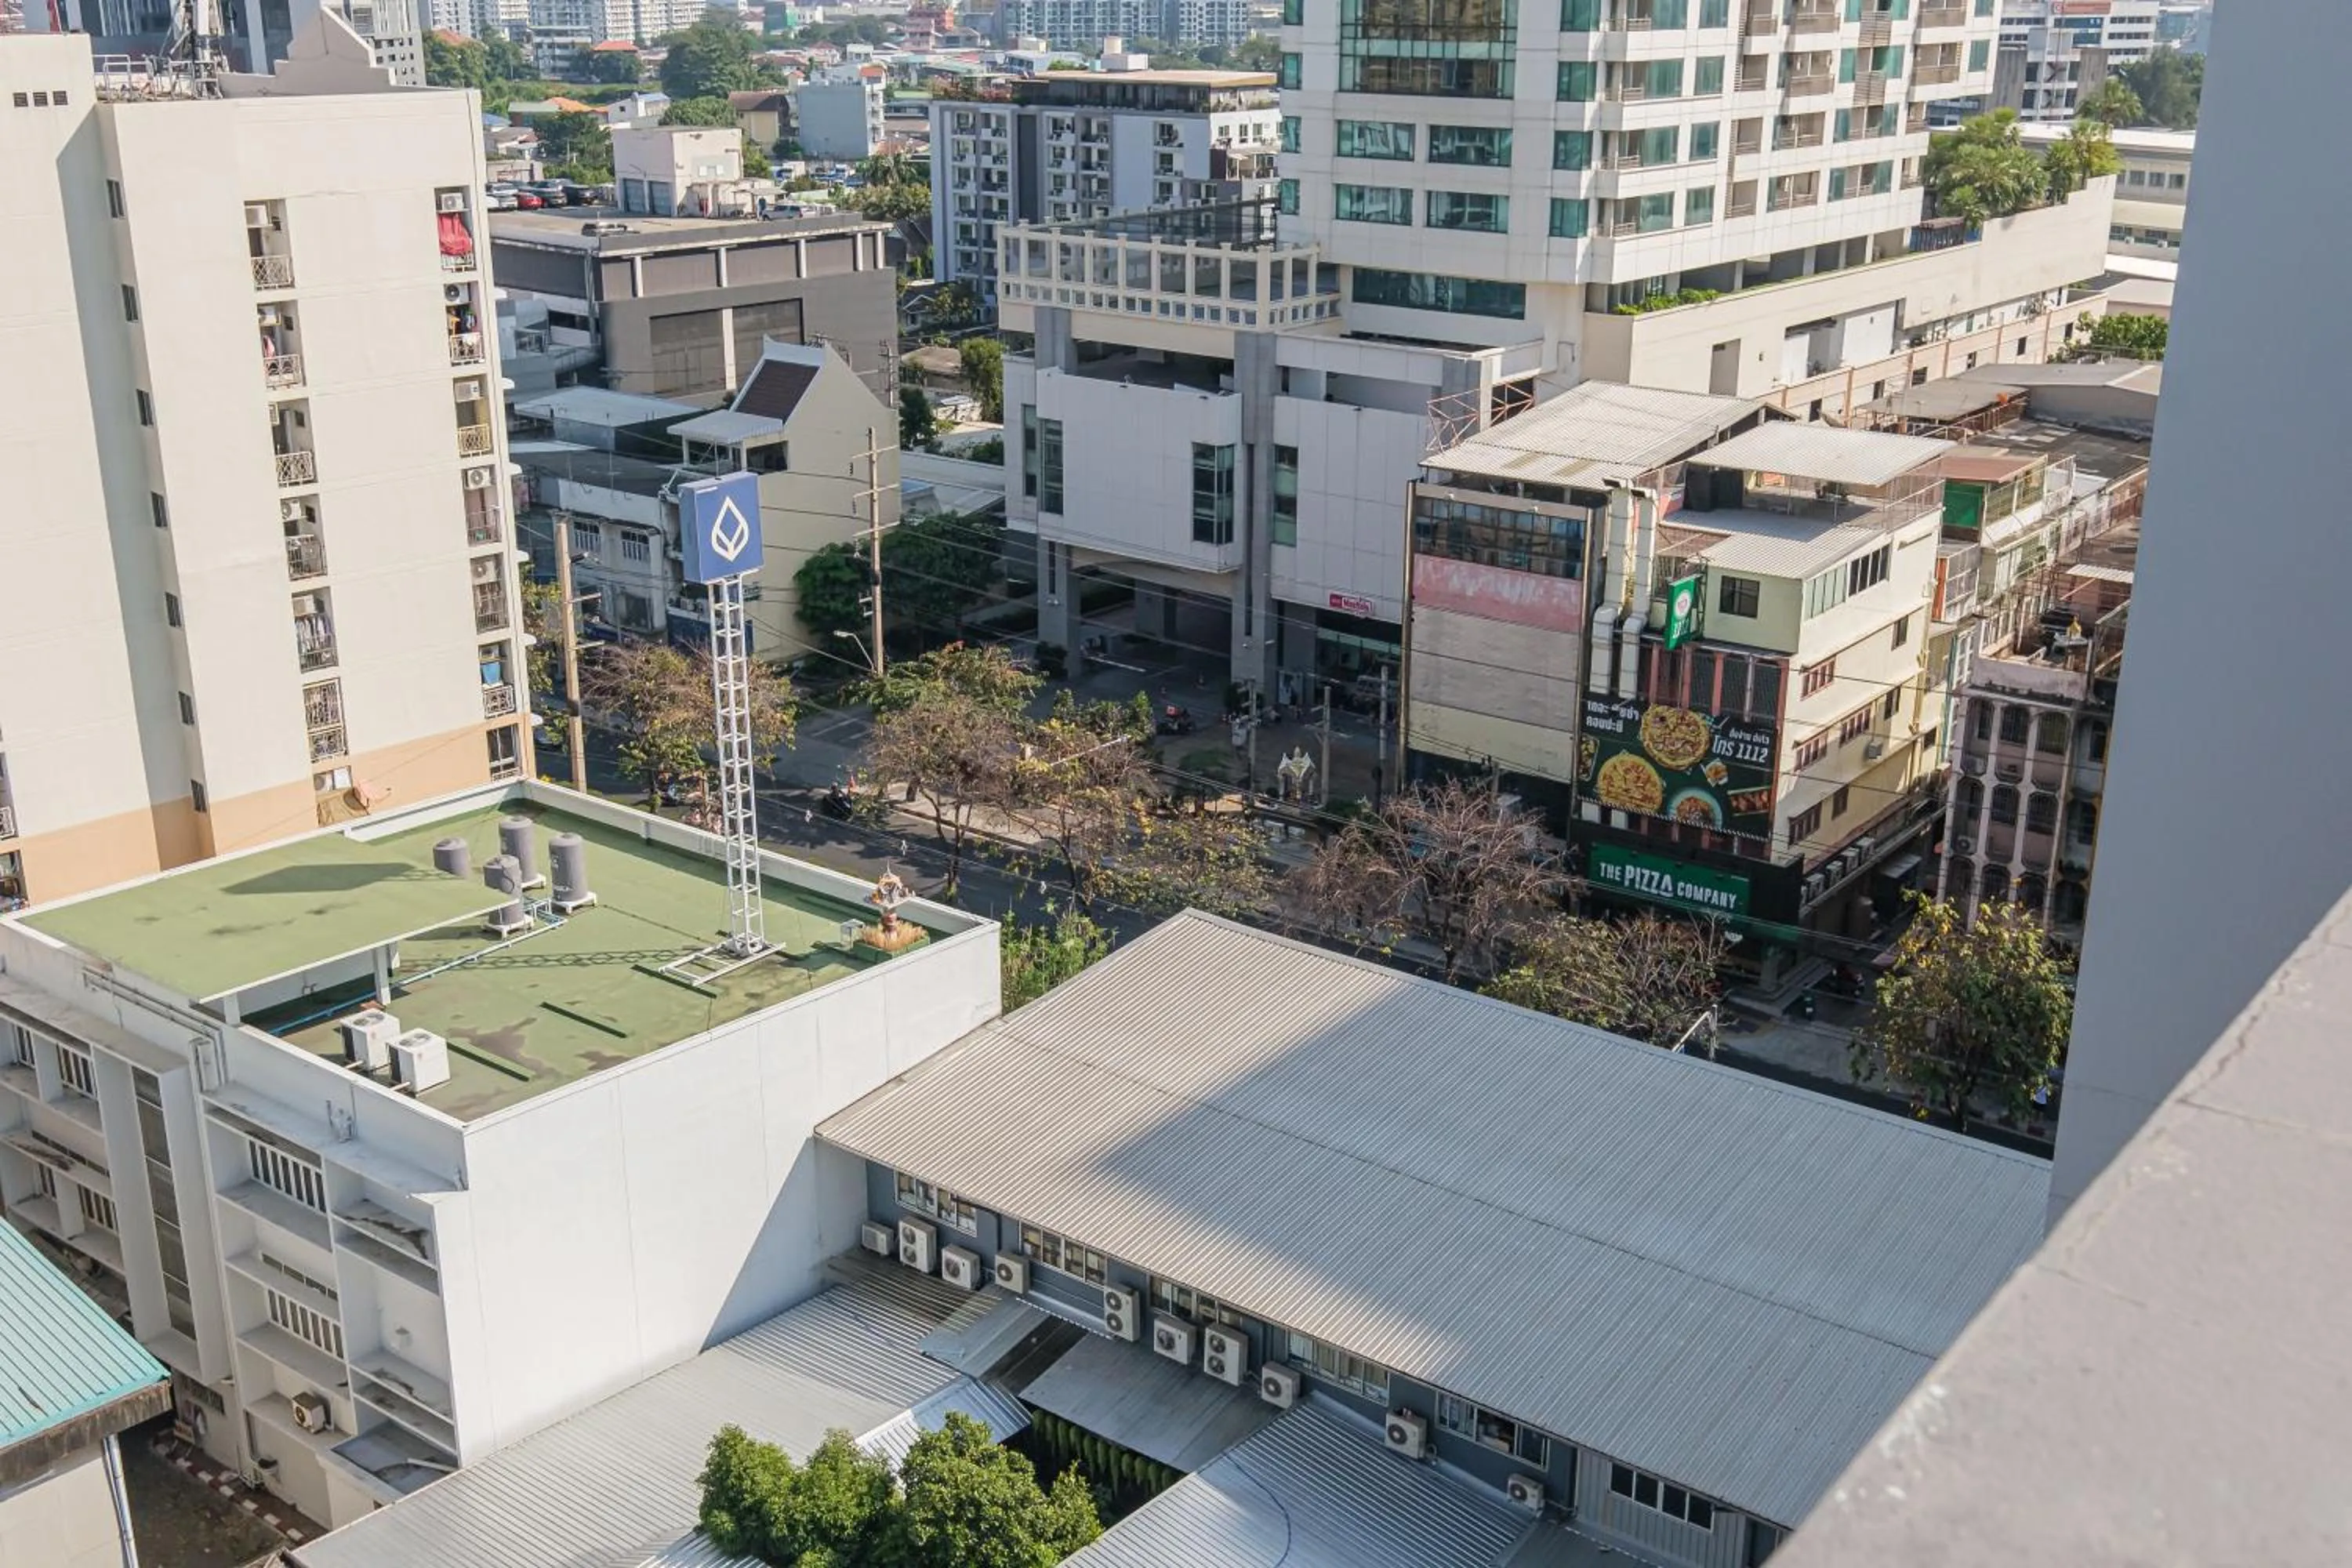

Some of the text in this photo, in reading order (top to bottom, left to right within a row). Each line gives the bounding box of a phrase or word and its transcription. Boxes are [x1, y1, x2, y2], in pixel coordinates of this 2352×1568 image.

[1712, 735, 1769, 763] โทร 1112
[1599, 862, 1737, 909] THE PIZZA COMPANY
